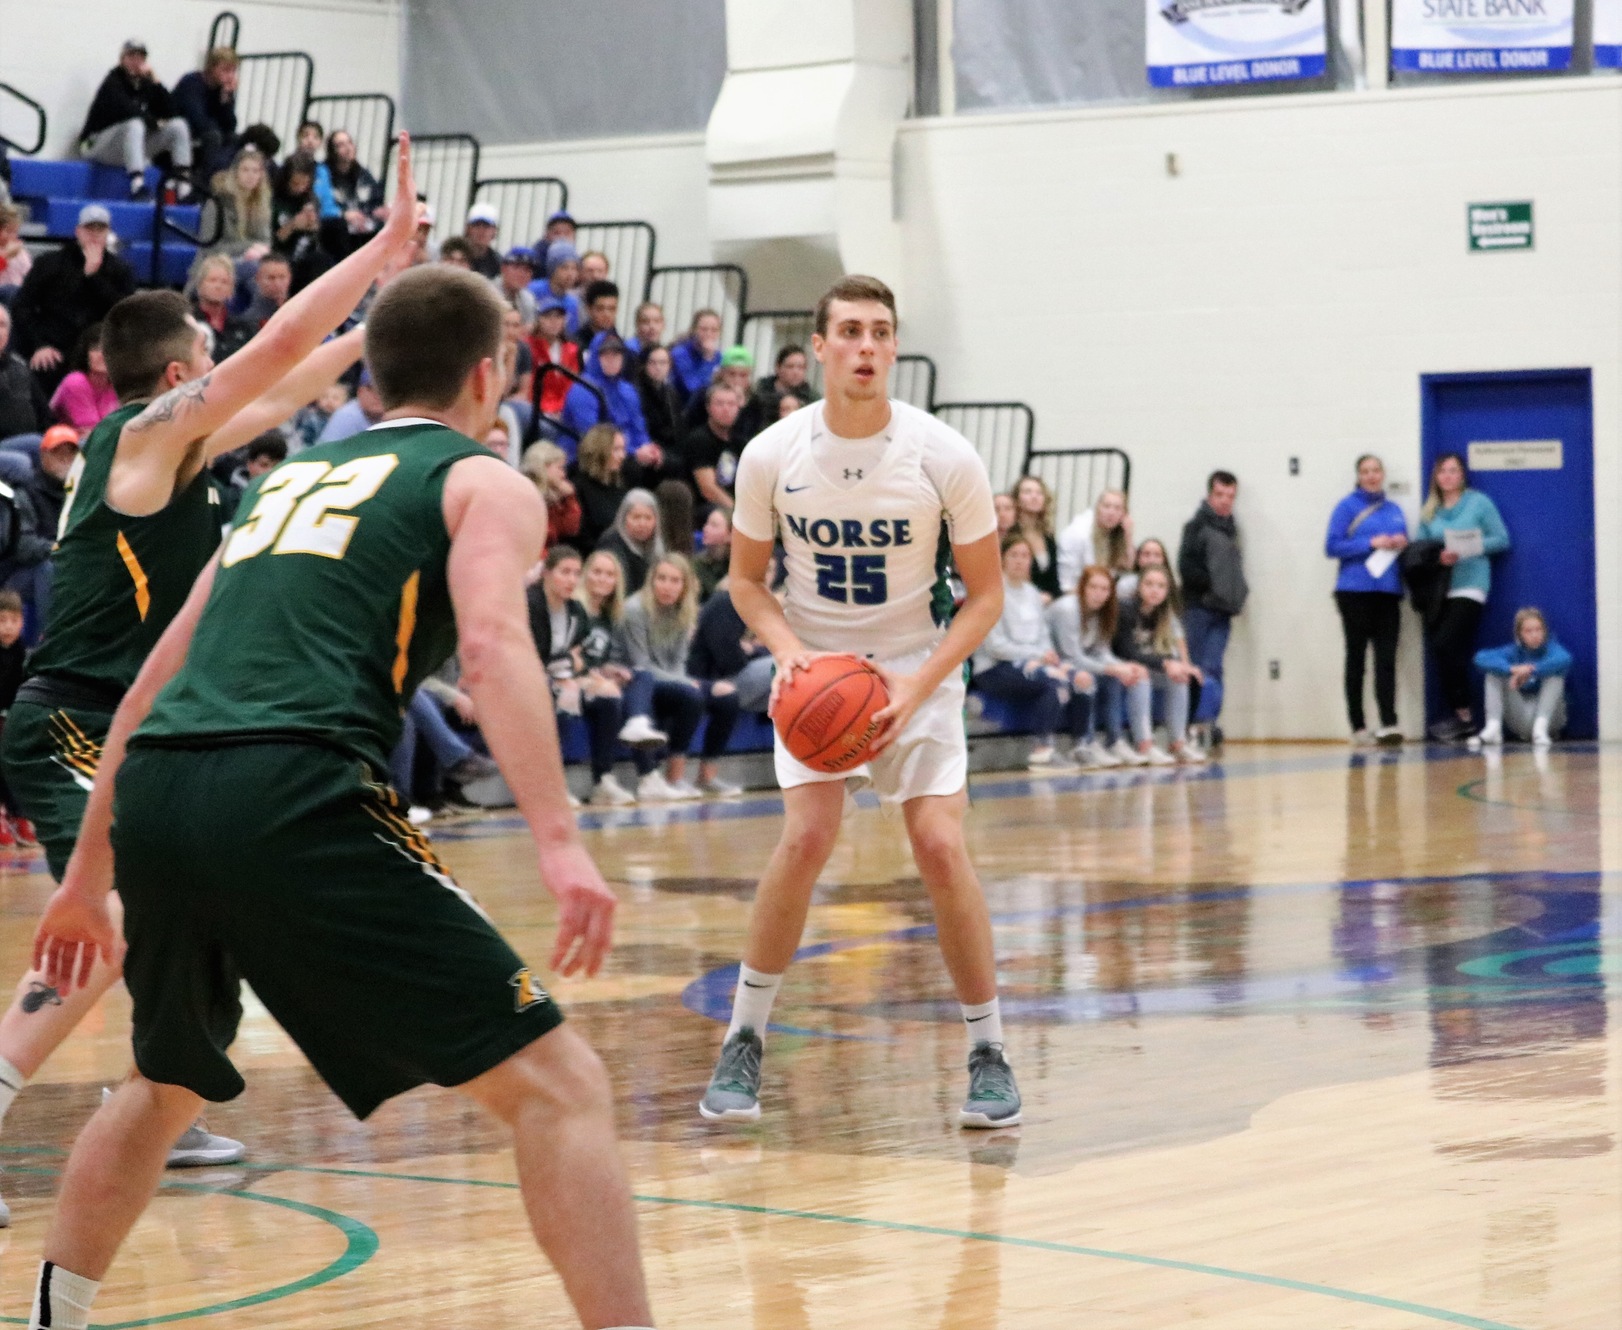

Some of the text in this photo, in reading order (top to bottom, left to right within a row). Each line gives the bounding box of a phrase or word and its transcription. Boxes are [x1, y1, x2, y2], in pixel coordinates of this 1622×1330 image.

[1484, 0, 1547, 17] BANK
[1172, 59, 1299, 84] BLUE LEVEL DONOR
[1418, 50, 1548, 68] BLUE LEVEL DONOR
[222, 453, 400, 569] 32
[785, 513, 912, 548] NORSE
[813, 552, 888, 605] 25
